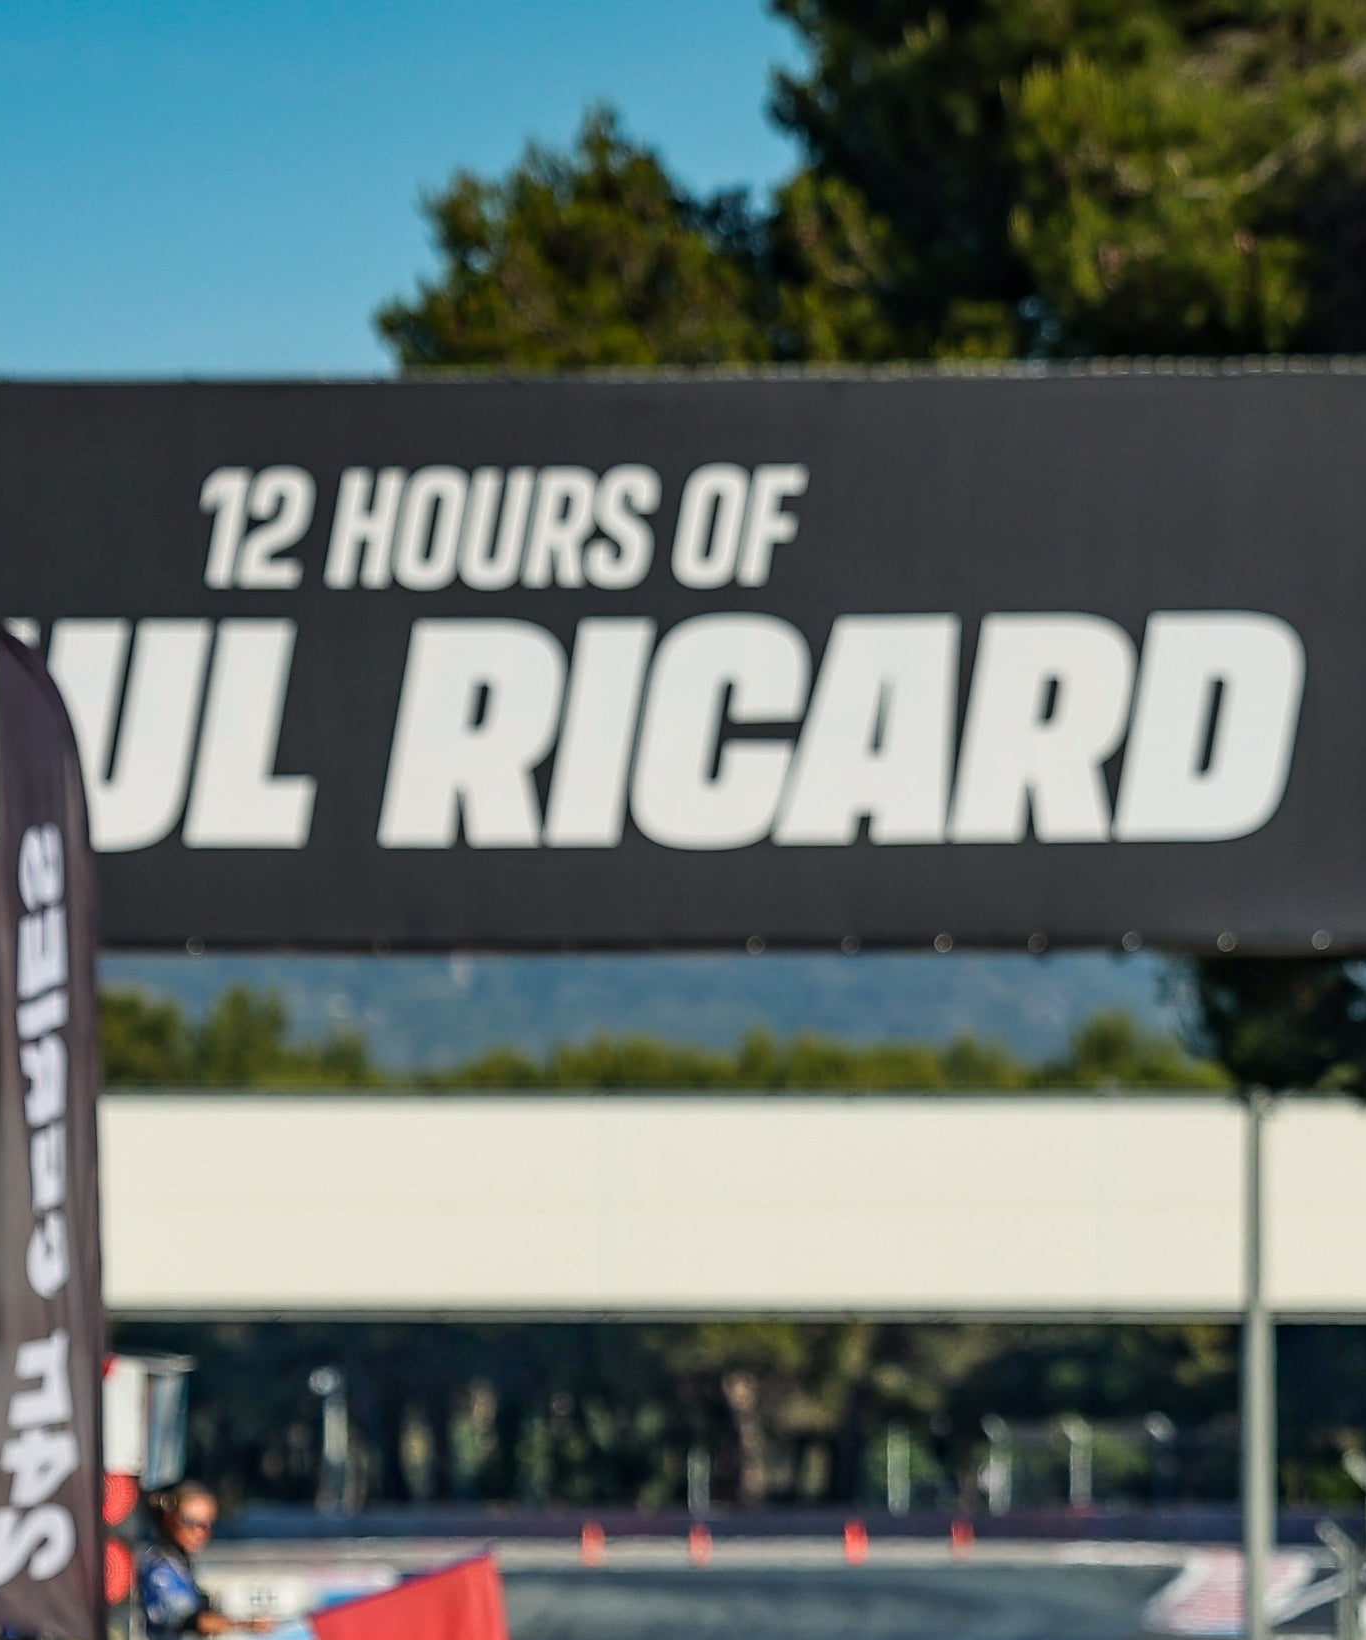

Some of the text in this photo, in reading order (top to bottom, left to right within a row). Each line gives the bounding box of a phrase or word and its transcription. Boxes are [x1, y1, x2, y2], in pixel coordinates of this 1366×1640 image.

[200, 464, 808, 590] 12 HOURS OF
[377, 612, 1306, 851] RICARD
